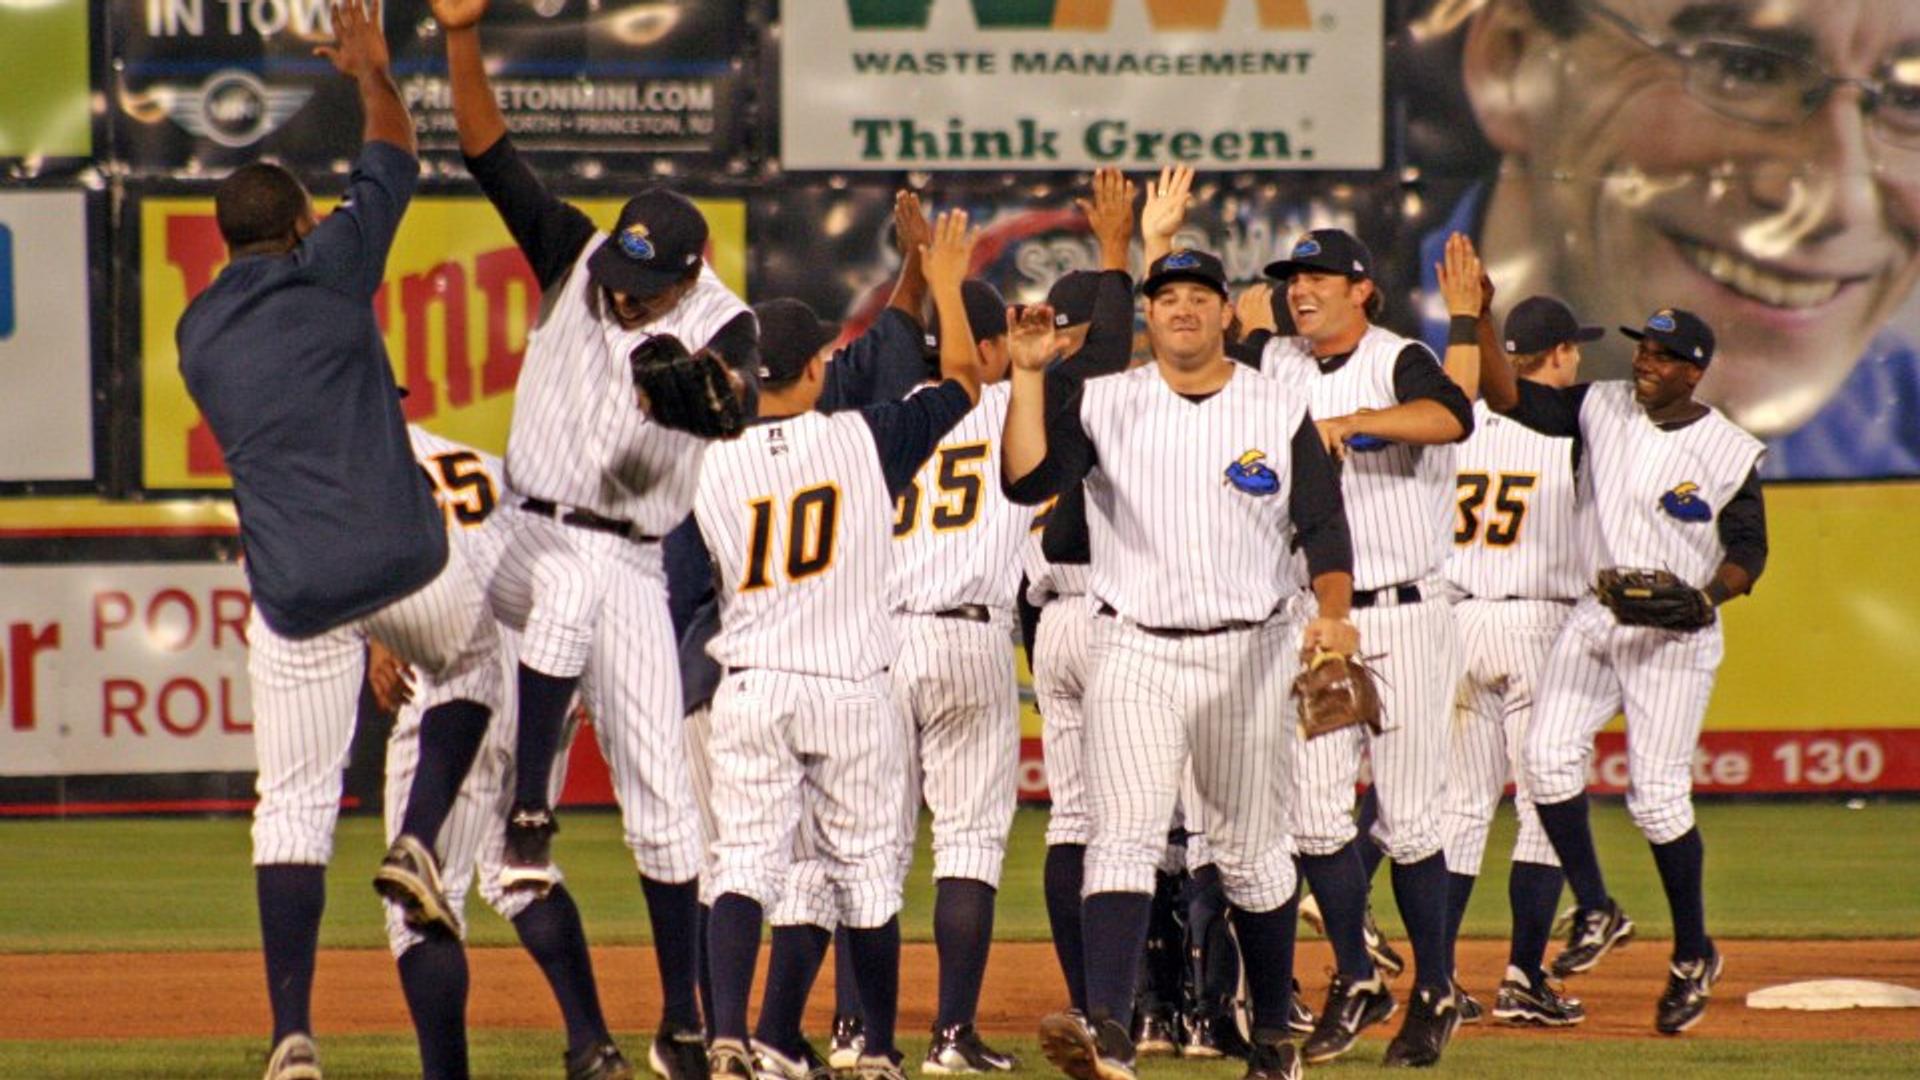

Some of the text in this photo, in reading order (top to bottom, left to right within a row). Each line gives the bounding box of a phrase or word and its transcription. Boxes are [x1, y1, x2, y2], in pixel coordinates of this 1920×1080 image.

[146, 0, 204, 36] IN
[853, 52, 1313, 76] WASTE MANAGEMENT
[404, 82, 713, 111] PRIETONMINI.COM
[852, 118, 1314, 161] Think Green.
[417, 450, 497, 528] 5
[1455, 470, 1540, 549] 35
[739, 479, 843, 592] 10
[92, 588, 252, 650] POR
[103, 676, 255, 738] ROL
[1772, 738, 1884, 784] 130
